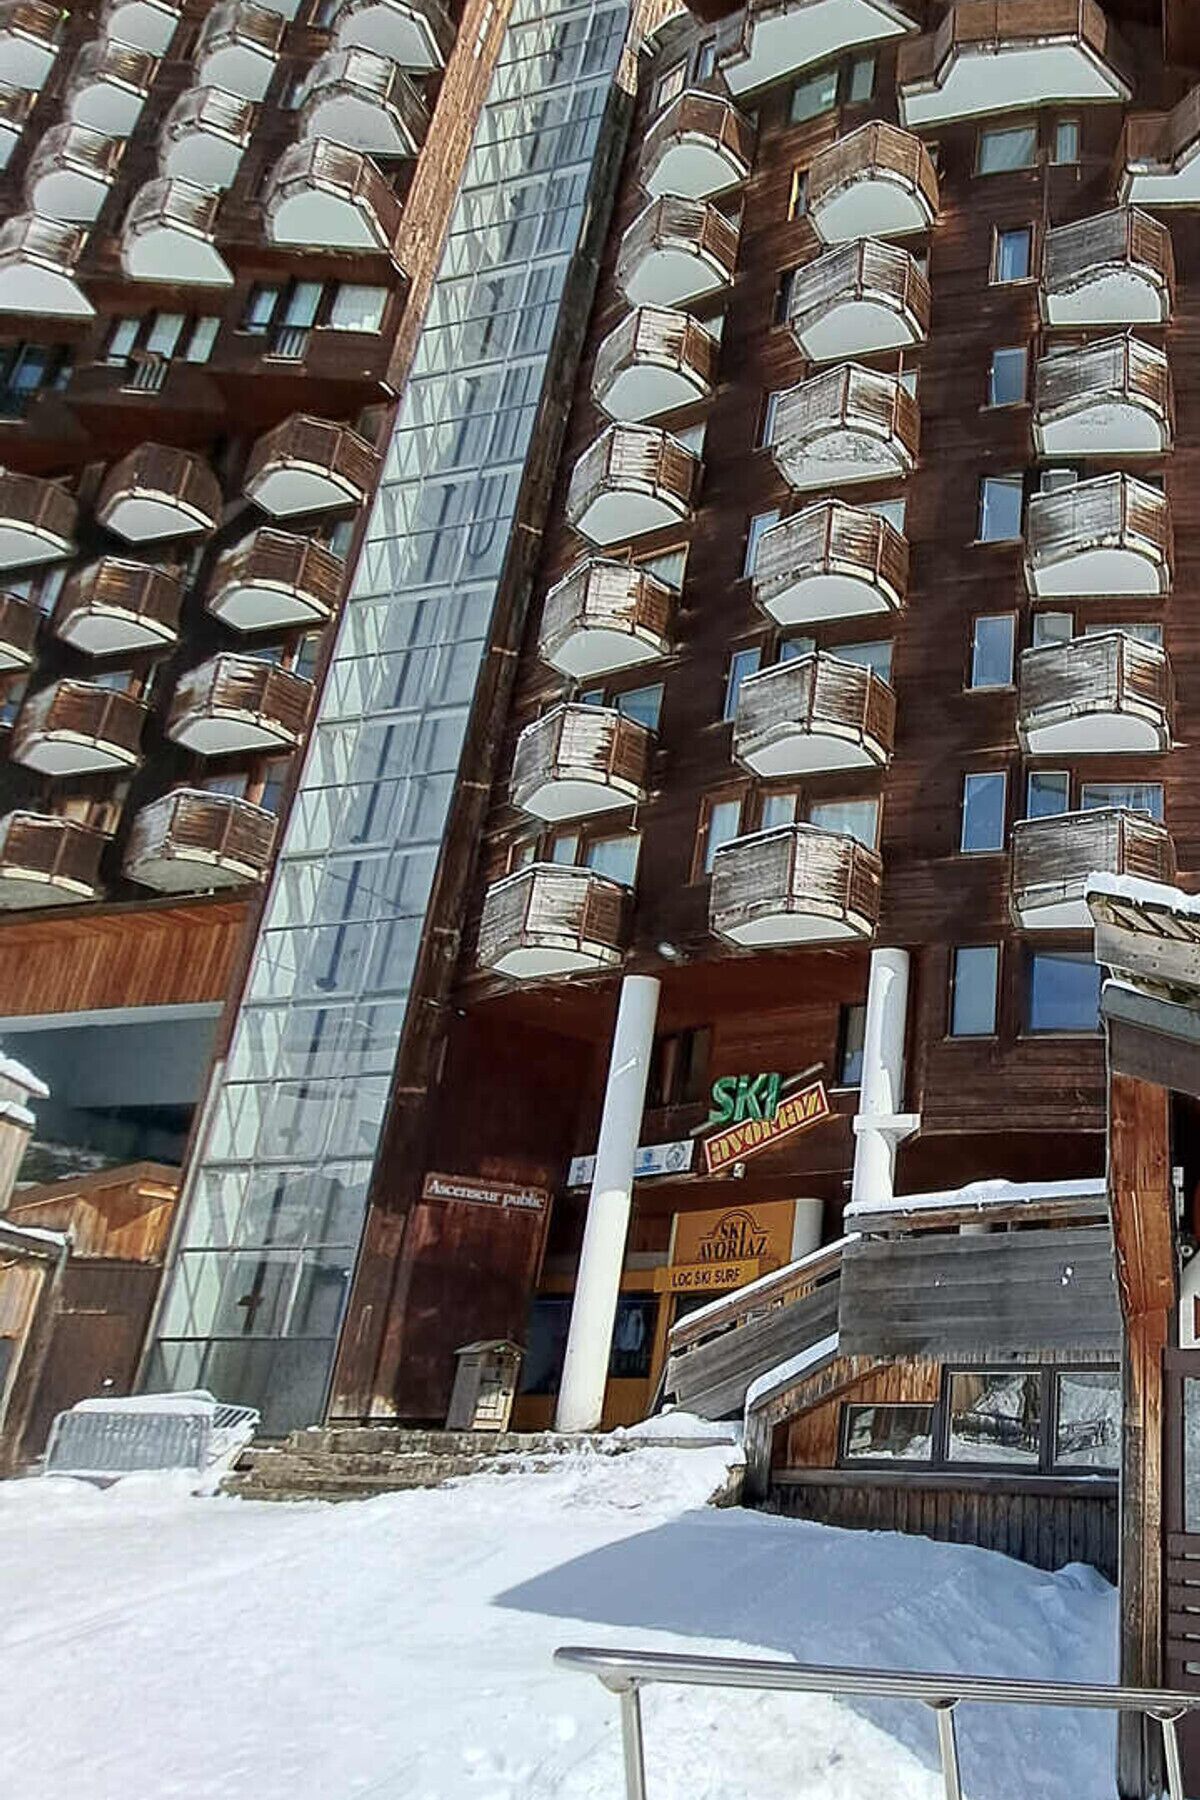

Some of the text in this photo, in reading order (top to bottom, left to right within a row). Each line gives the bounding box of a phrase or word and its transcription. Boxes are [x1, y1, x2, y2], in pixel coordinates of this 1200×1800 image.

[427, 1180, 544, 1209] Ascenseur public
[720, 1220, 747, 1242] SKI
[698, 1236, 768, 1262] AVORIAZ
[671, 1267, 741, 1288] LOC SKI SURF
